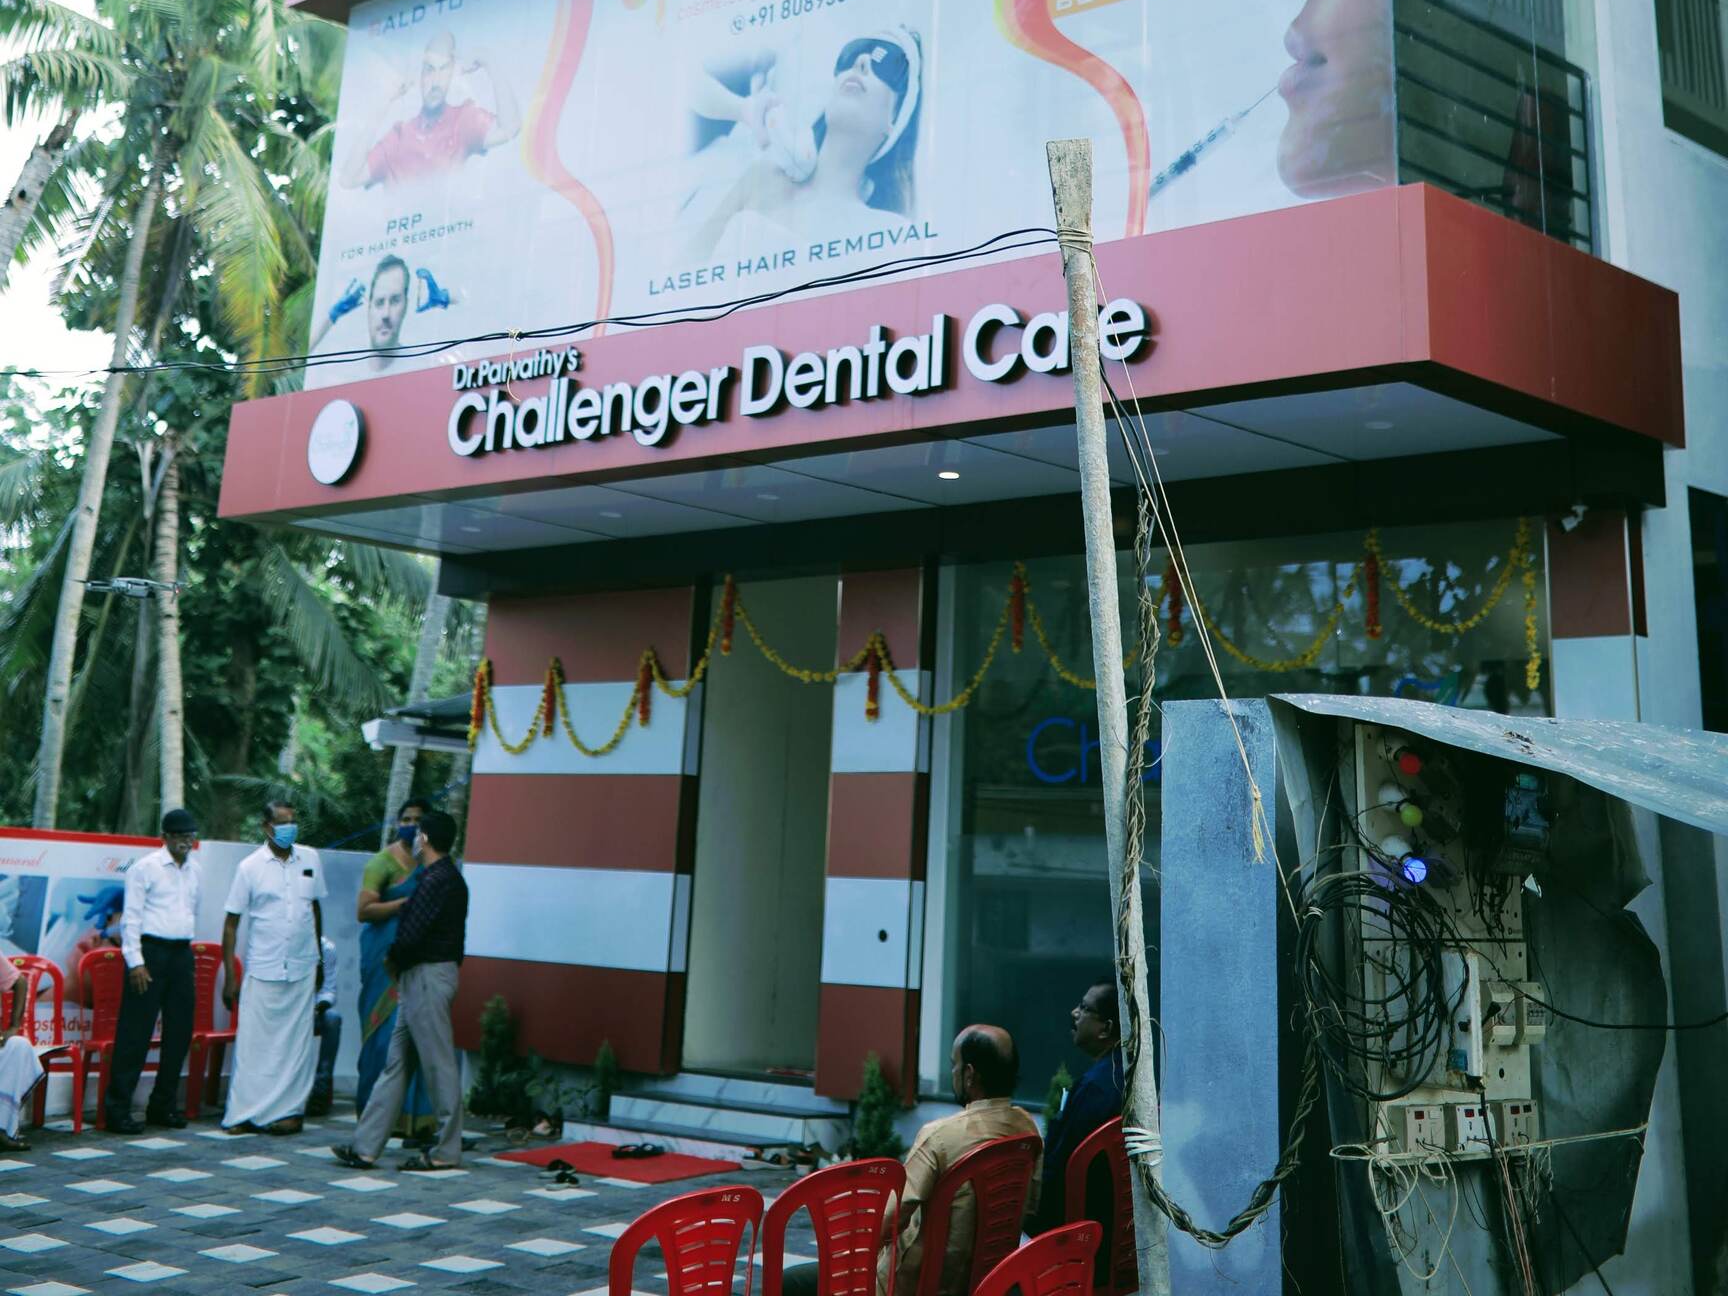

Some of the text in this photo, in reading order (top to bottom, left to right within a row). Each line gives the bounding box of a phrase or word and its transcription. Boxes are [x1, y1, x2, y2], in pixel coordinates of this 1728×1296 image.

[748, 3, 775, 28] +91
[368, 238, 398, 255] HAIR
[402, 219, 475, 246] REGROWTH
[386, 213, 423, 236] PRP
[649, 221, 939, 296] LASER HAIR REMOVAL
[448, 297, 1147, 457] Challenger Dental Cae
